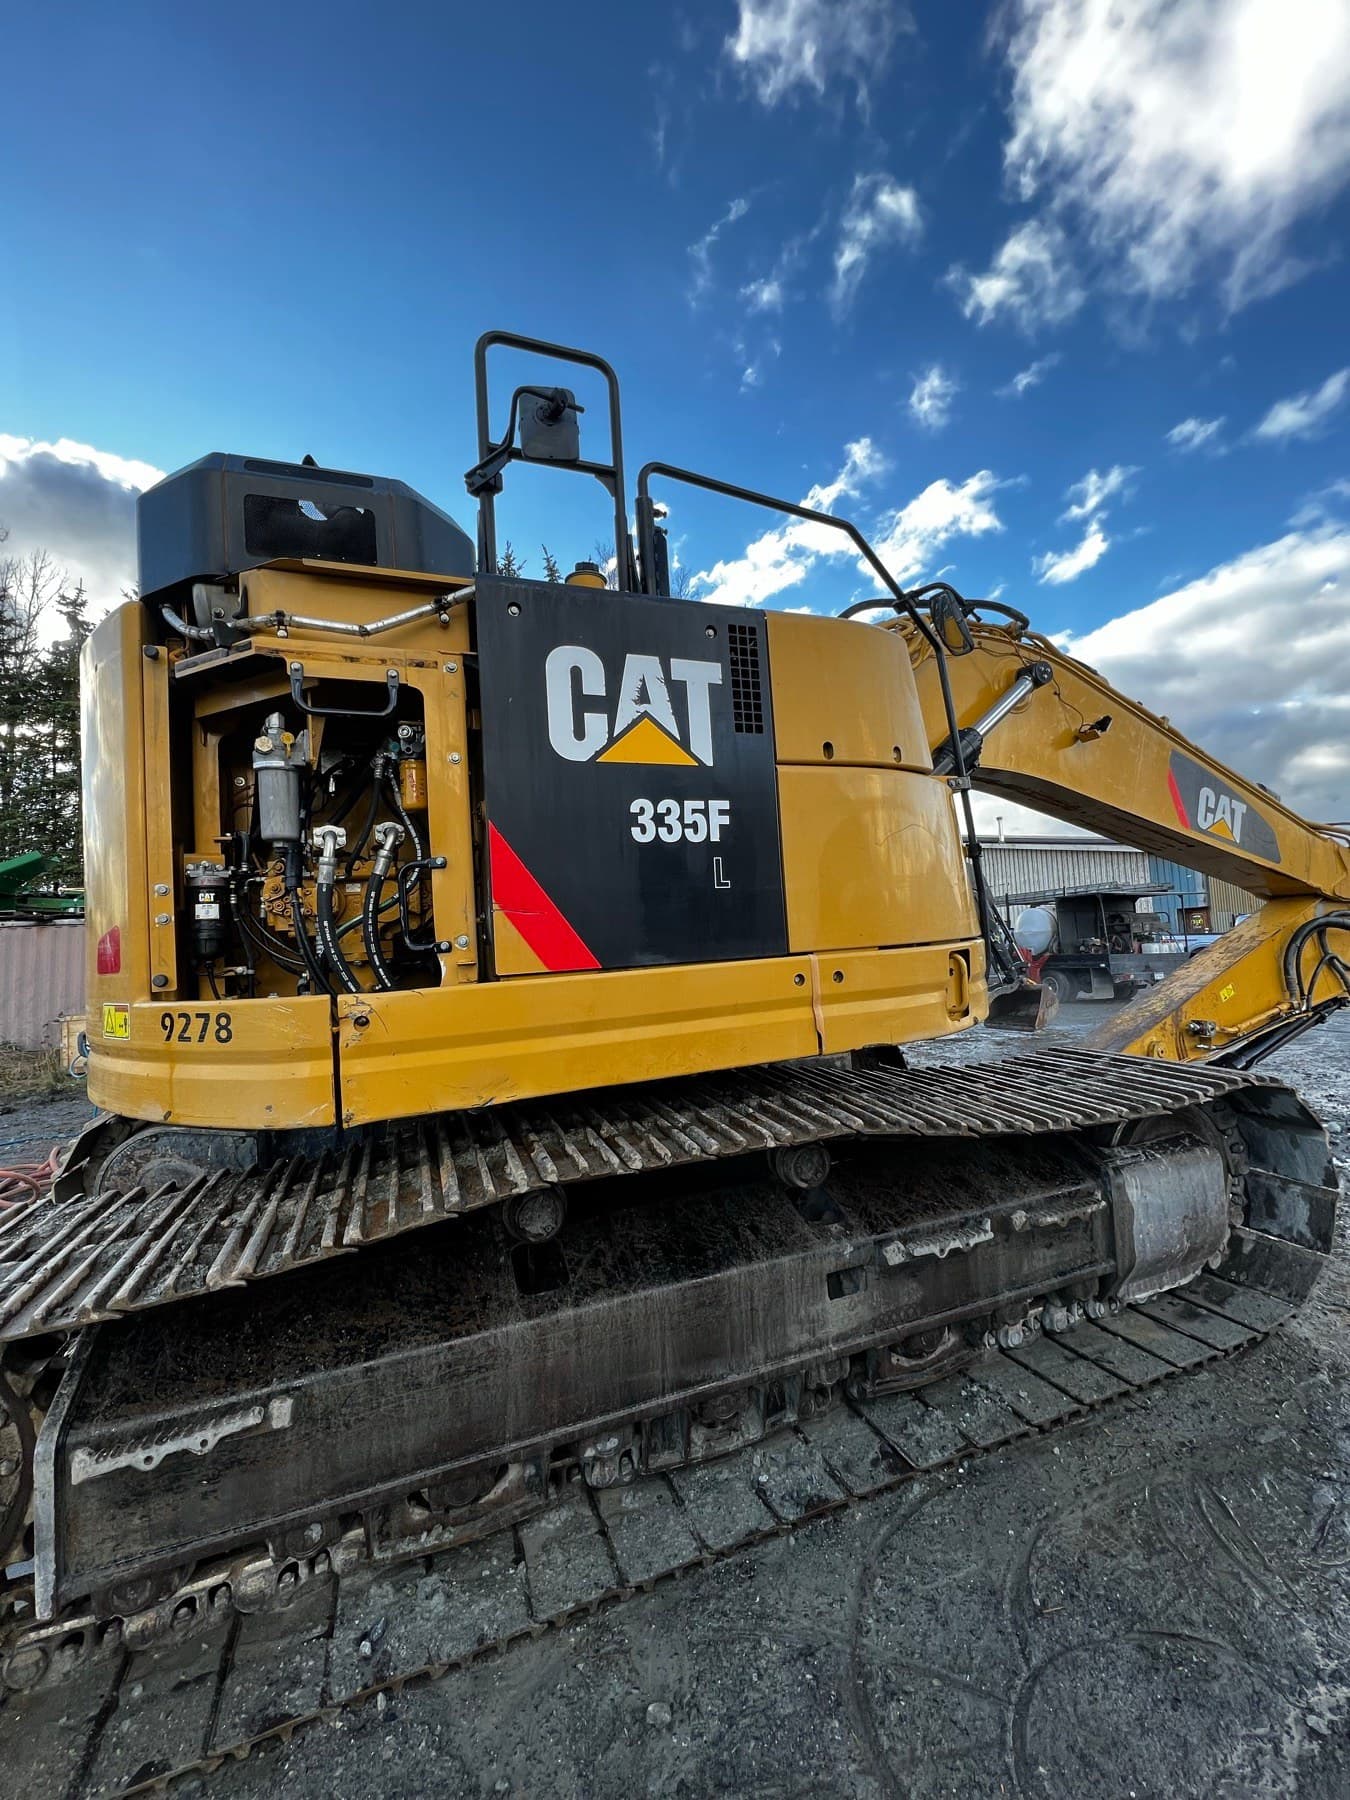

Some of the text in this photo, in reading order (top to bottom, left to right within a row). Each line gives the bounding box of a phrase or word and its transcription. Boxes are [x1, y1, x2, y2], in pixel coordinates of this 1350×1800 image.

[545, 645, 723, 767] CAT
[630, 798, 730, 843] 335F
[1197, 786, 1247, 844] CAT
[713, 857, 731, 889] L
[198, 892, 216, 902] CAT
[160, 1012, 233, 1043] 9278
